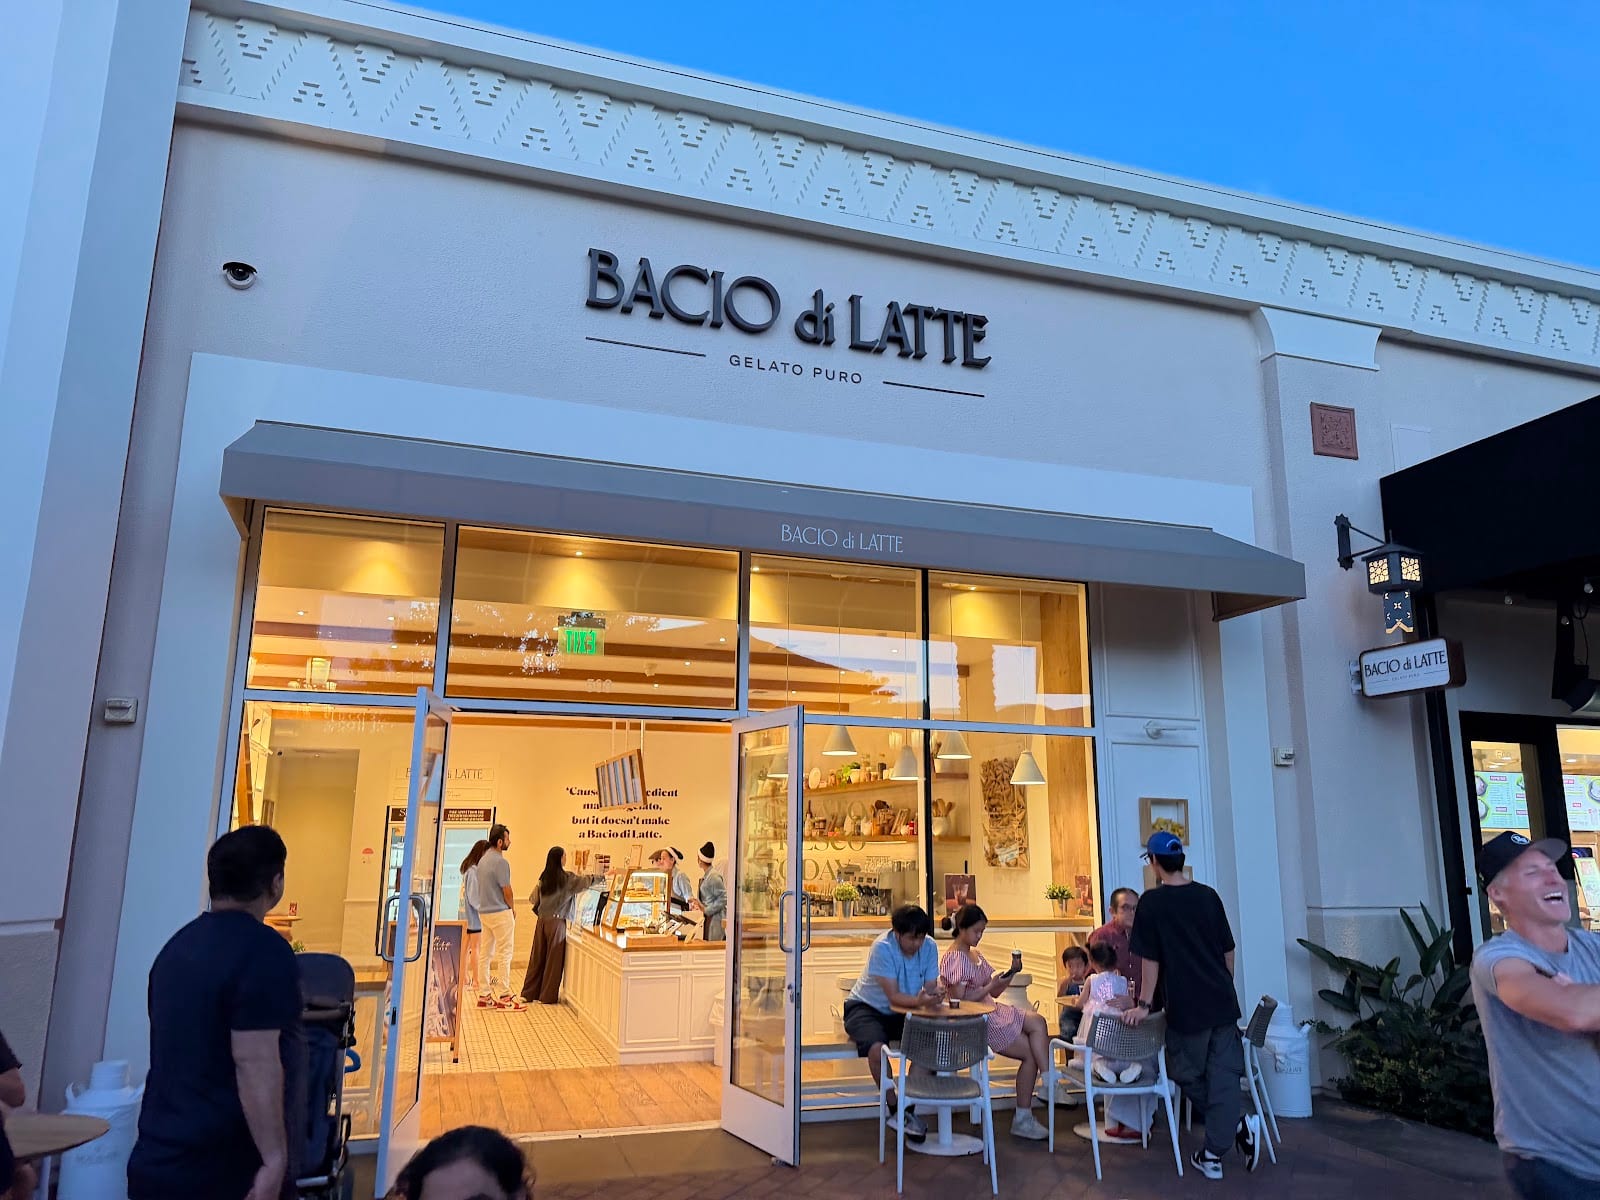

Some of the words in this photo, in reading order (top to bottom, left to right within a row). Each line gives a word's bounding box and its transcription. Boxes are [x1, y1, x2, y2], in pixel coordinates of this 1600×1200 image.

[585, 247, 781, 334] BACIO
[794, 288, 836, 346] di
[848, 293, 992, 369] LATTE
[728, 354, 804, 376] GELATO
[813, 366, 863, 385] PURO
[781, 523, 838, 547] BACIO
[842, 531, 855, 549] di
[859, 532, 904, 553] LATTE
[1364, 659, 1401, 678] BACIO
[1402, 657, 1412, 671] di
[1413, 650, 1447, 669] LATTE
[455, 768, 483, 780] LATTE
[646, 788, 678, 797] edient
[571, 815, 590, 825] but
[591, 815, 600, 825] it
[600, 815, 640, 825] doesn't
[641, 816, 671, 825] make
[578, 831, 585, 839] a
[587, 829, 618, 839] Bacio
[619, 829, 631, 839] di
